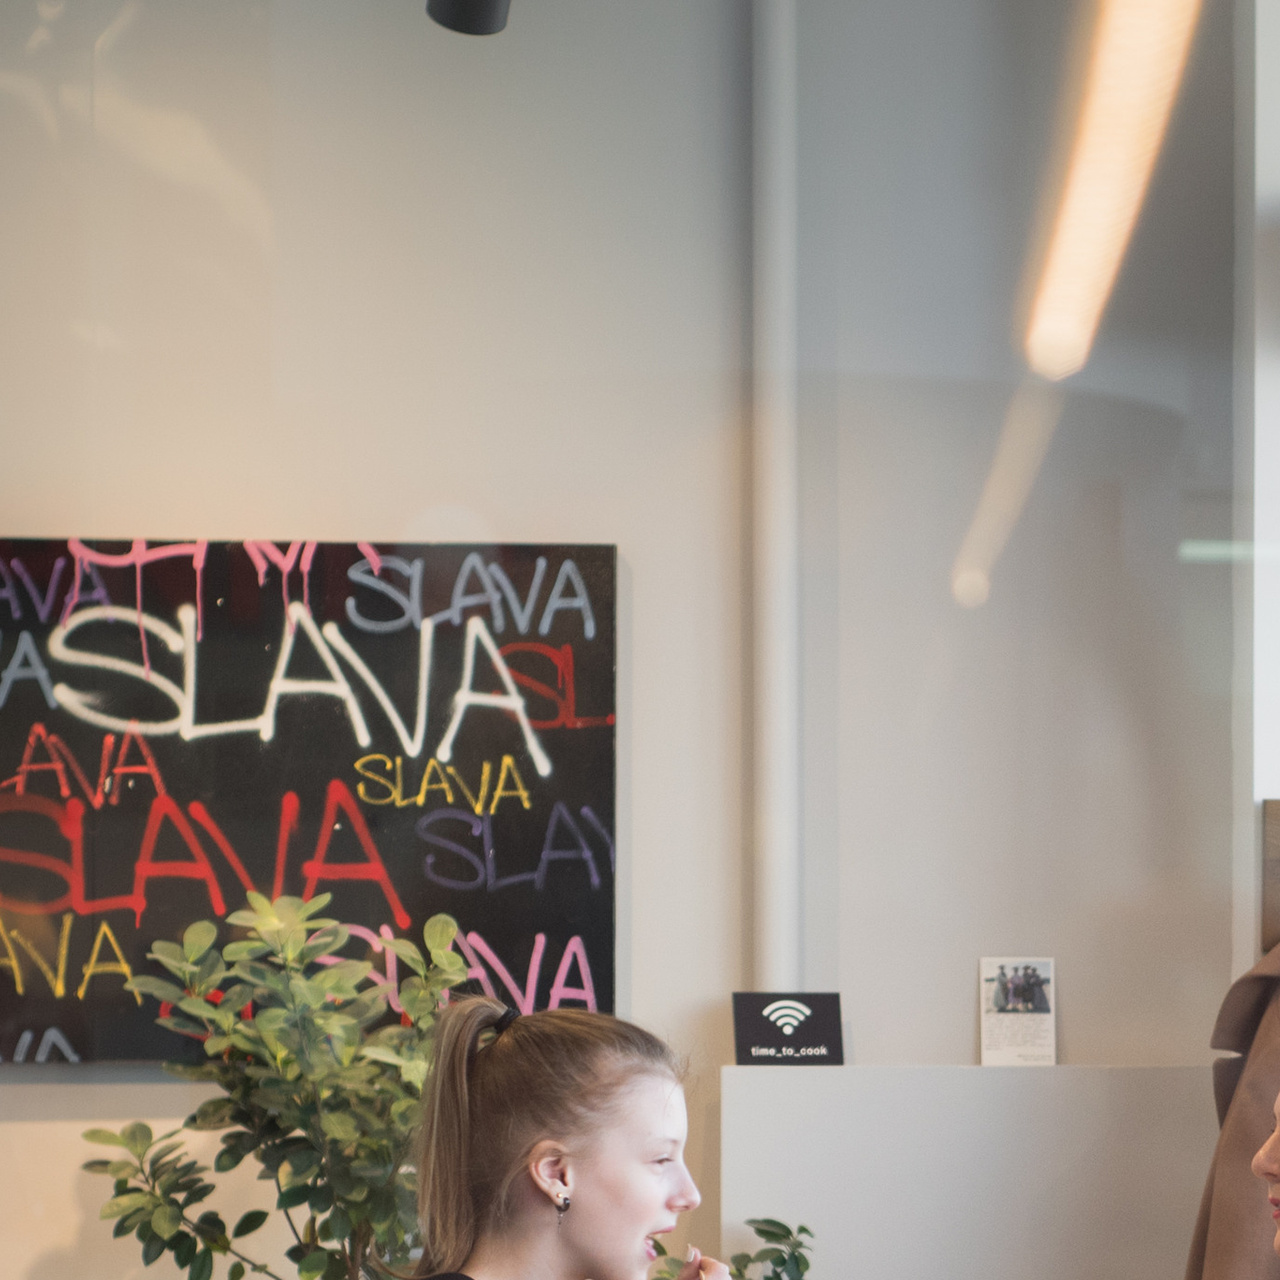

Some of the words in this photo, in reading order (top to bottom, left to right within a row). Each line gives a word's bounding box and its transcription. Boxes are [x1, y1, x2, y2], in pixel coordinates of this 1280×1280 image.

[345, 552, 597, 641] SLAVA
[48, 600, 552, 778] SLAVA
[0, 722, 167, 810] AVA
[354, 753, 532, 816] SLAVA
[750, 1045, 828, 1058] time_to_cook
